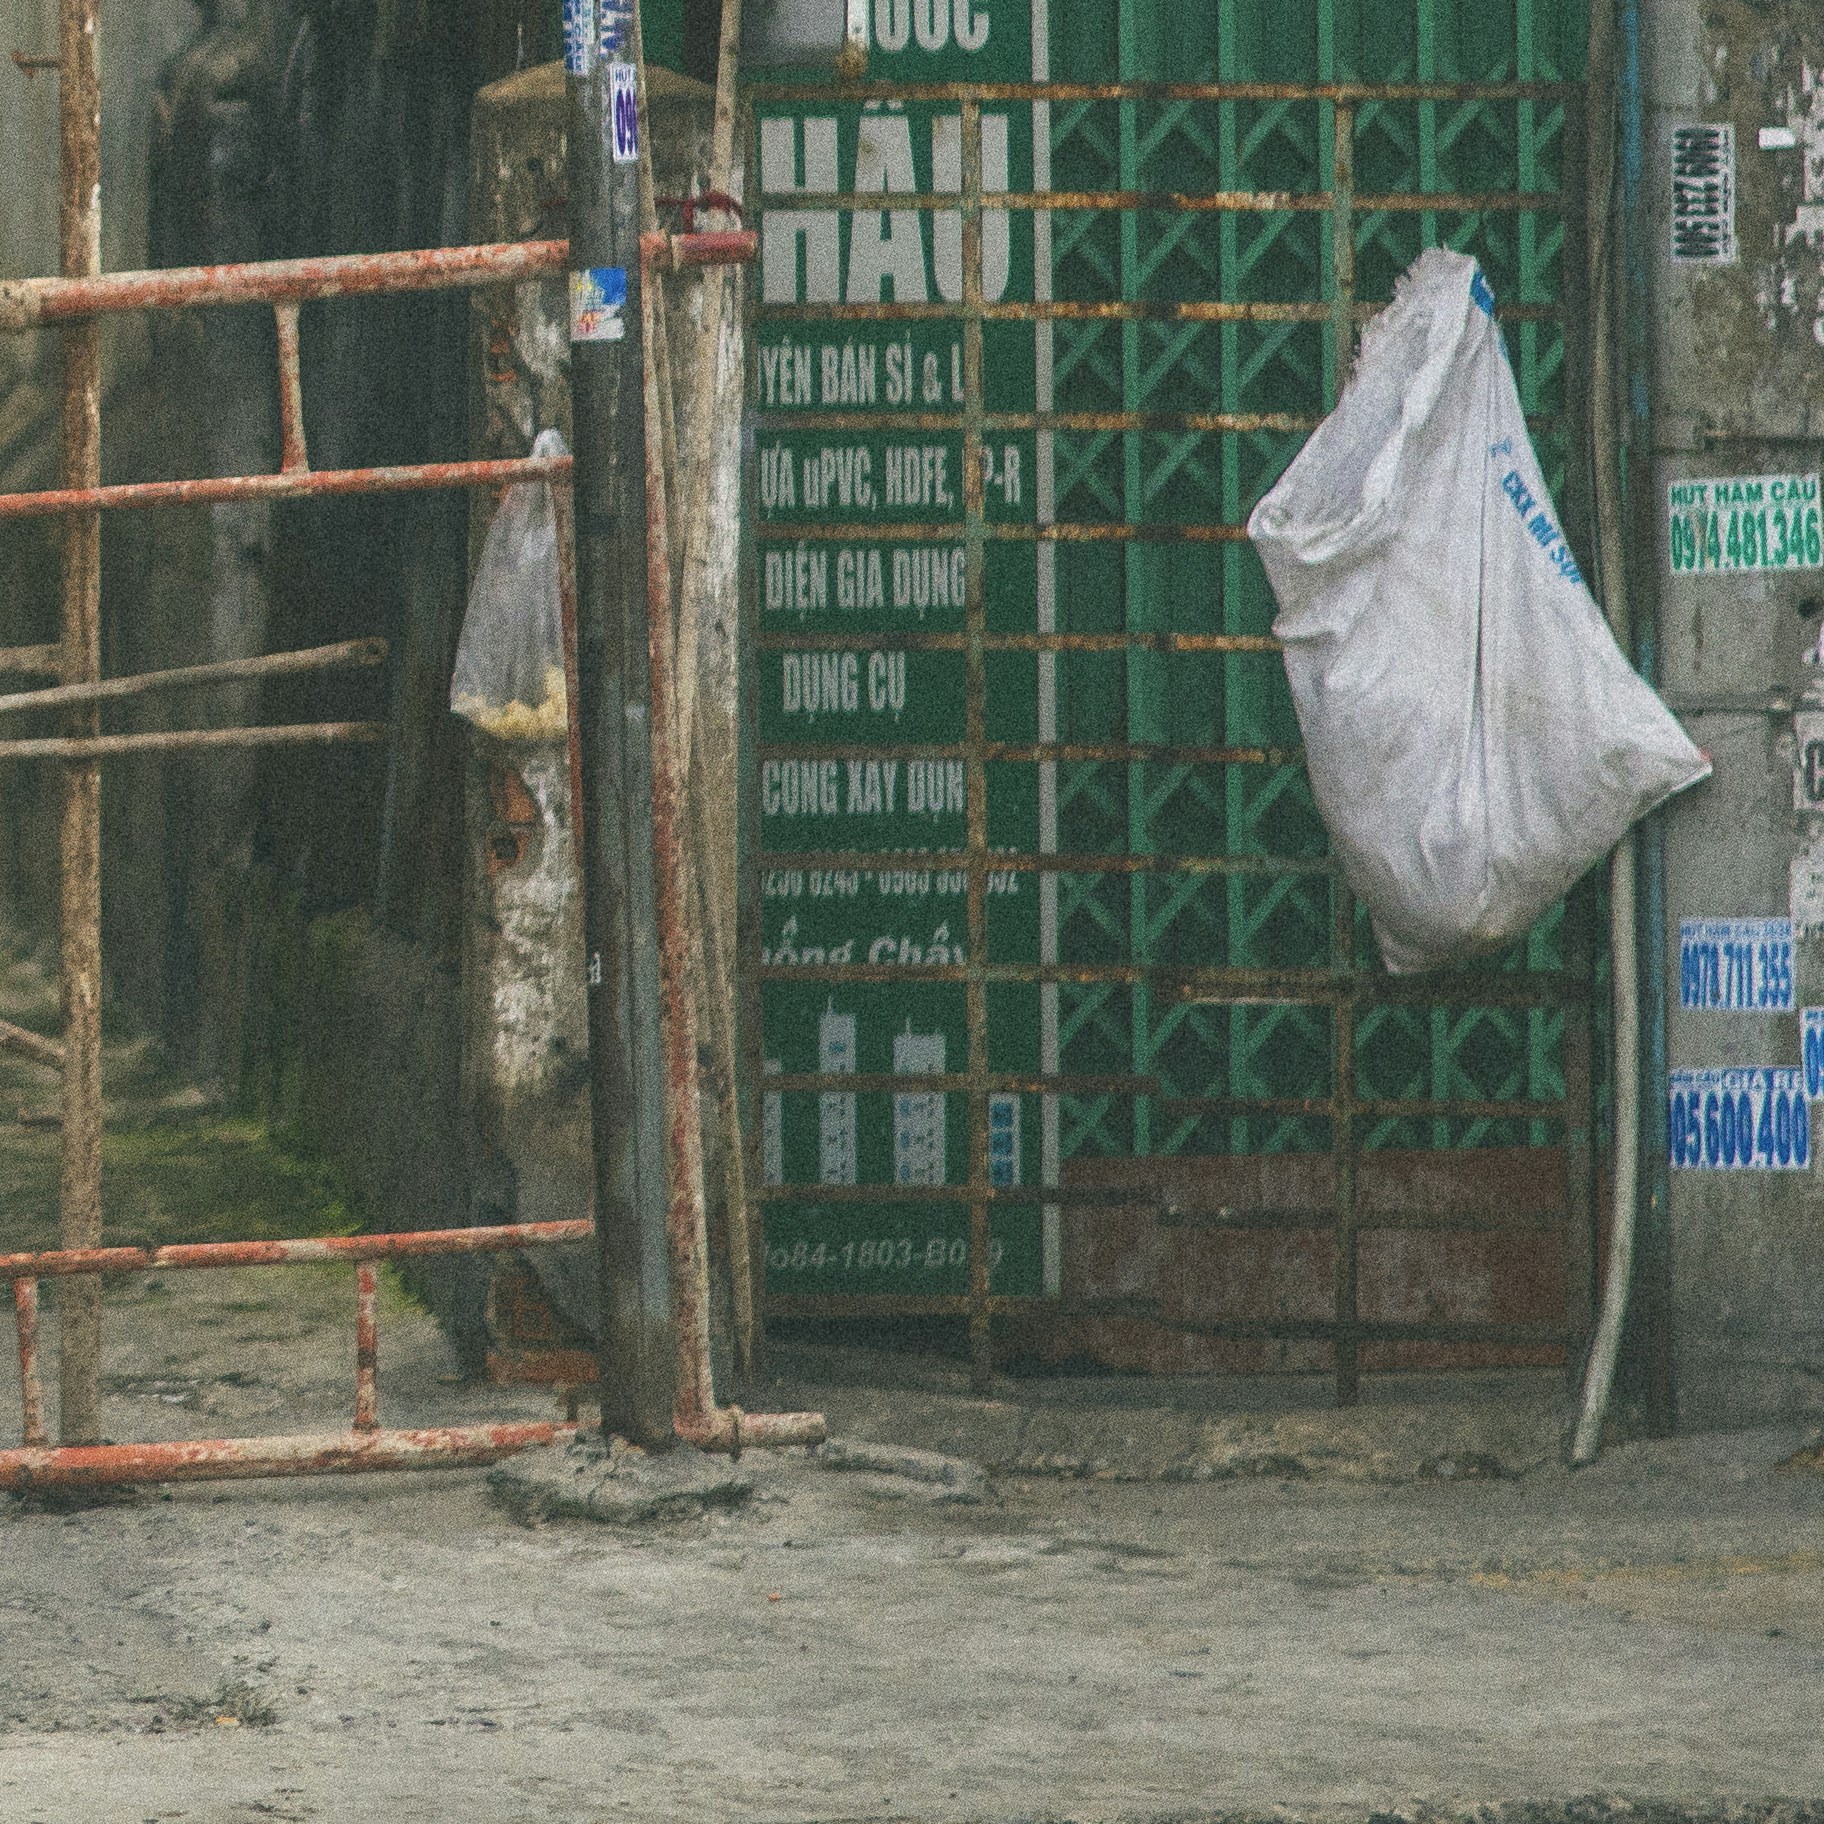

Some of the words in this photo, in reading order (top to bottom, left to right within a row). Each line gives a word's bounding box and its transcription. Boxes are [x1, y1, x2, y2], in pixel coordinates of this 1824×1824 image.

[759, 336, 813, 406] YÊN
[821, 336, 877, 406] BÁN
[760, 438, 797, 520] ỰA
[802, 444, 878, 512] uPVC,
[836, 548, 885, 610] GIA
[781, 649, 859, 725] DỤNG
[867, 649, 907, 725] CỤ
